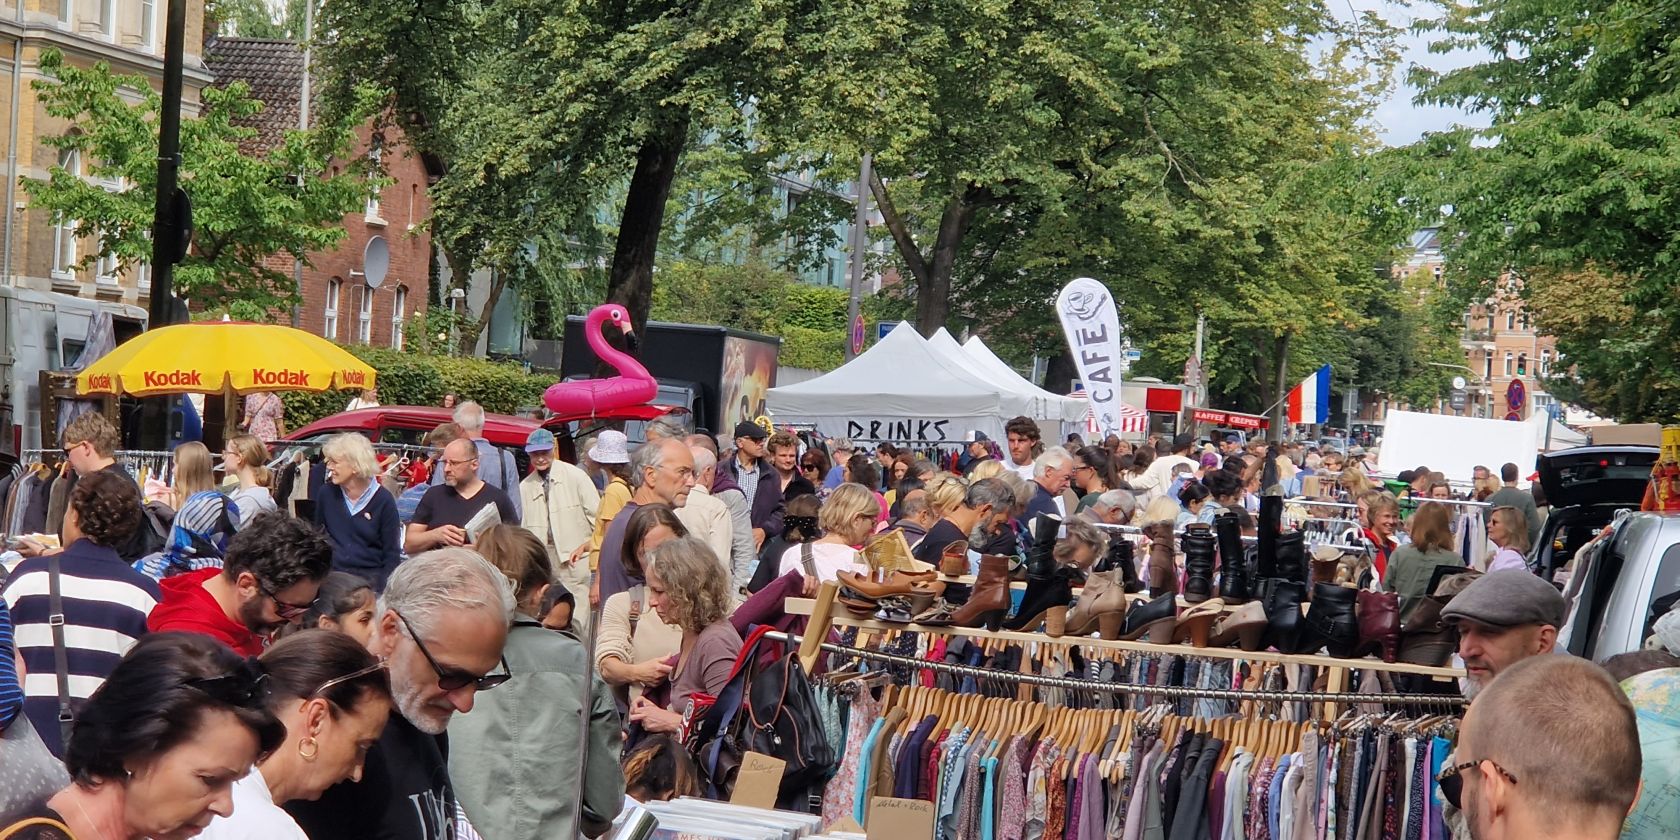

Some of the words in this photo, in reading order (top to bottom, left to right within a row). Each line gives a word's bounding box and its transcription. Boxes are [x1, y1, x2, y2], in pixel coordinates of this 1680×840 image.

[88, 373, 112, 389] Kodak
[144, 369, 202, 387] Kodak
[252, 368, 309, 387] Kodak
[342, 369, 365, 385] Kodak
[1194, 411, 1225, 422] KAFFEE
[847, 419, 950, 441] DRINKS
